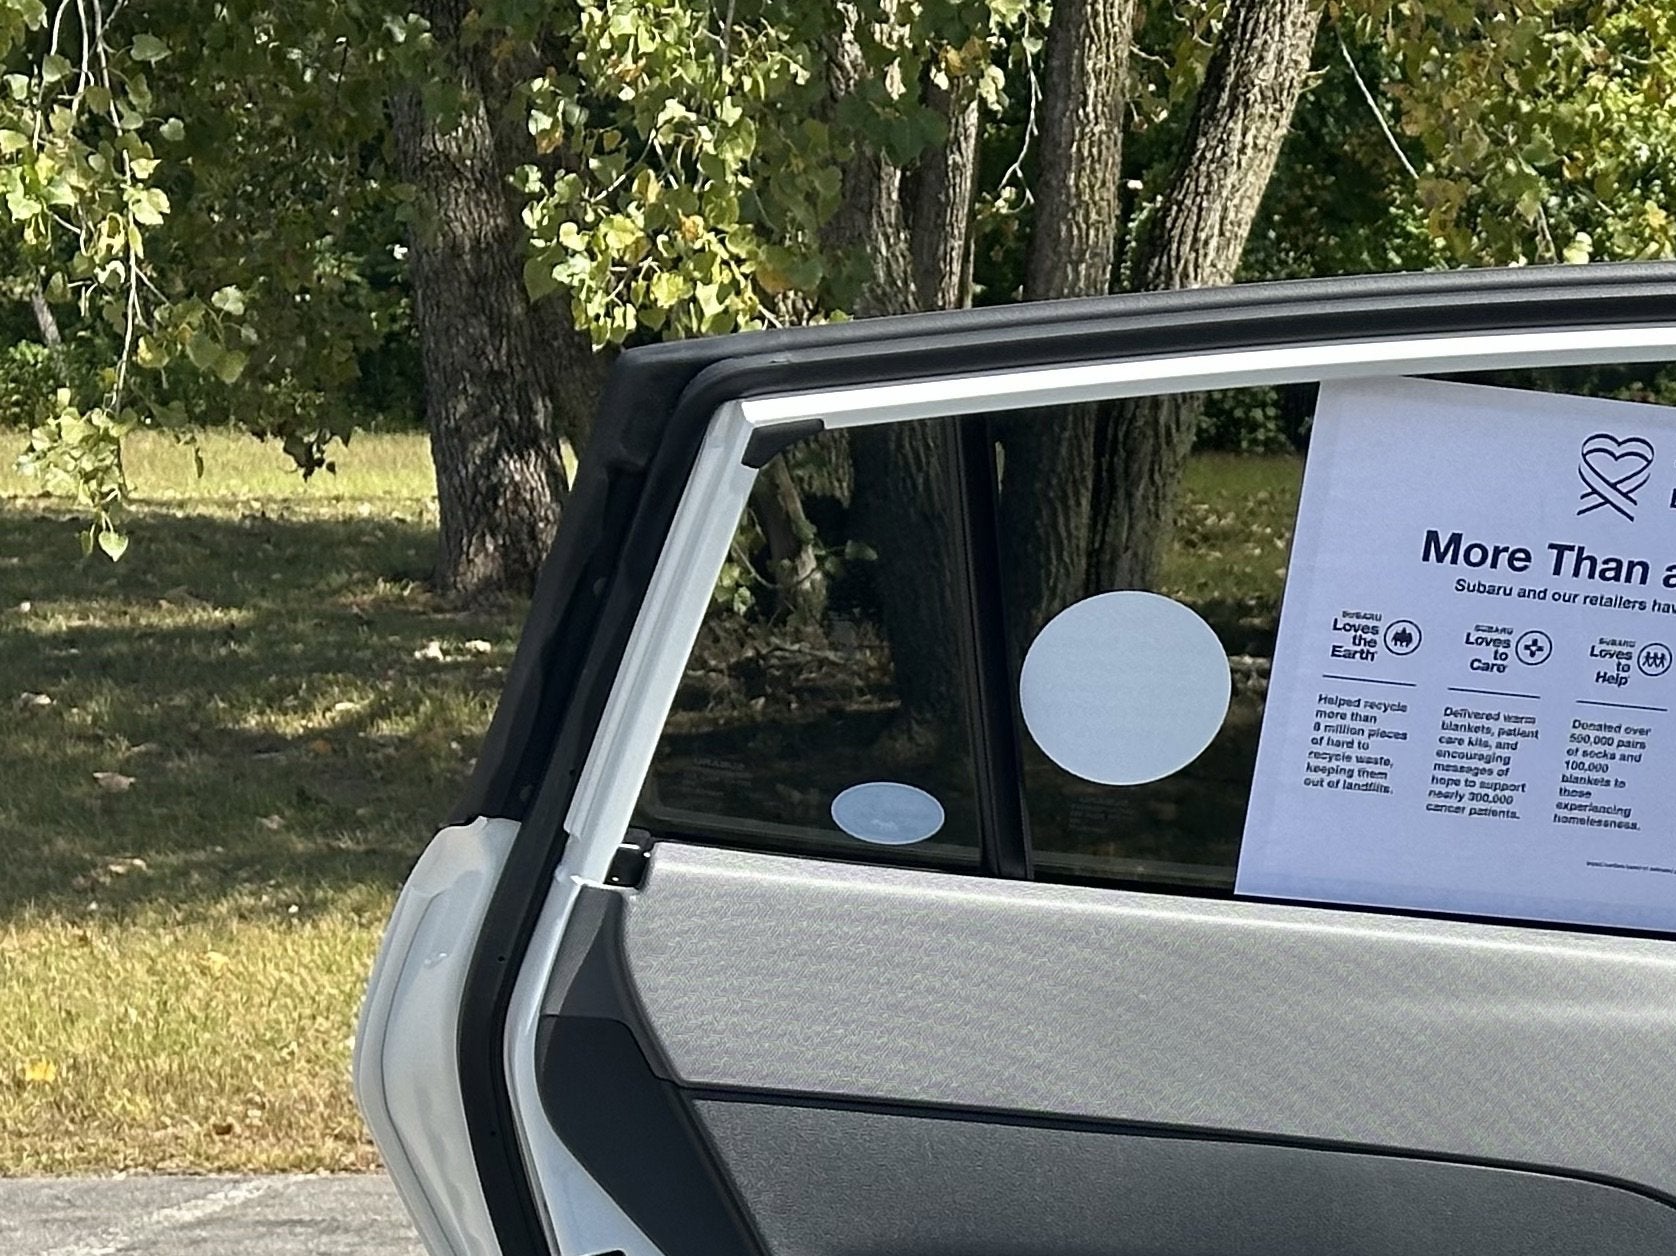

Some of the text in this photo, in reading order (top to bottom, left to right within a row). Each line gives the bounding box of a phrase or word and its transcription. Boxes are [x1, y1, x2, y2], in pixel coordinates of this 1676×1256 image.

[1421, 529, 1532, 573] More
[1546, 542, 1650, 585] Than
[1454, 577, 1513, 597] Subaru
[1516, 587, 1548, 601] and
[1550, 591, 1580, 604] our
[1582, 594, 1647, 611] retailers
[1331, 618, 1379, 636] Loves
[1351, 633, 1378, 648] the
[1464, 631, 1511, 649] Loves
[1492, 648, 1509, 661] to
[1588, 644, 1633, 661] Loves
[1469, 657, 1508, 674] Care
[1615, 660, 1631, 673] to
[1594, 670, 1630, 688] Help
[1317, 693, 1362, 708] Helped
[1314, 709, 1377, 724] more than
[1442, 706, 1501, 722] Delivered
[1323, 723, 1365, 736] million
[1367, 727, 1408, 741] pieces
[1496, 727, 1539, 740] patient
[1571, 718, 1652, 736] Donated over
[1310, 735, 1370, 751] of hard to
[1437, 735, 1465, 746] care
[1494, 740, 1519, 751] and
[1615, 738, 1647, 750] pairs
[1435, 749, 1511, 766] encouraging
[1565, 746, 1642, 763] of socks and
[1305, 761, 1355, 779] keeping
[1432, 762, 1510, 777] messages of
[1303, 777, 1325, 788] out
[1326, 778, 1341, 789] of
[1430, 774, 1526, 793] hope to support
[1560, 773, 1626, 789] blankets to
[1427, 786, 1466, 803] nearly
[1558, 786, 1592, 799] those
[1425, 802, 1466, 814] cancer
